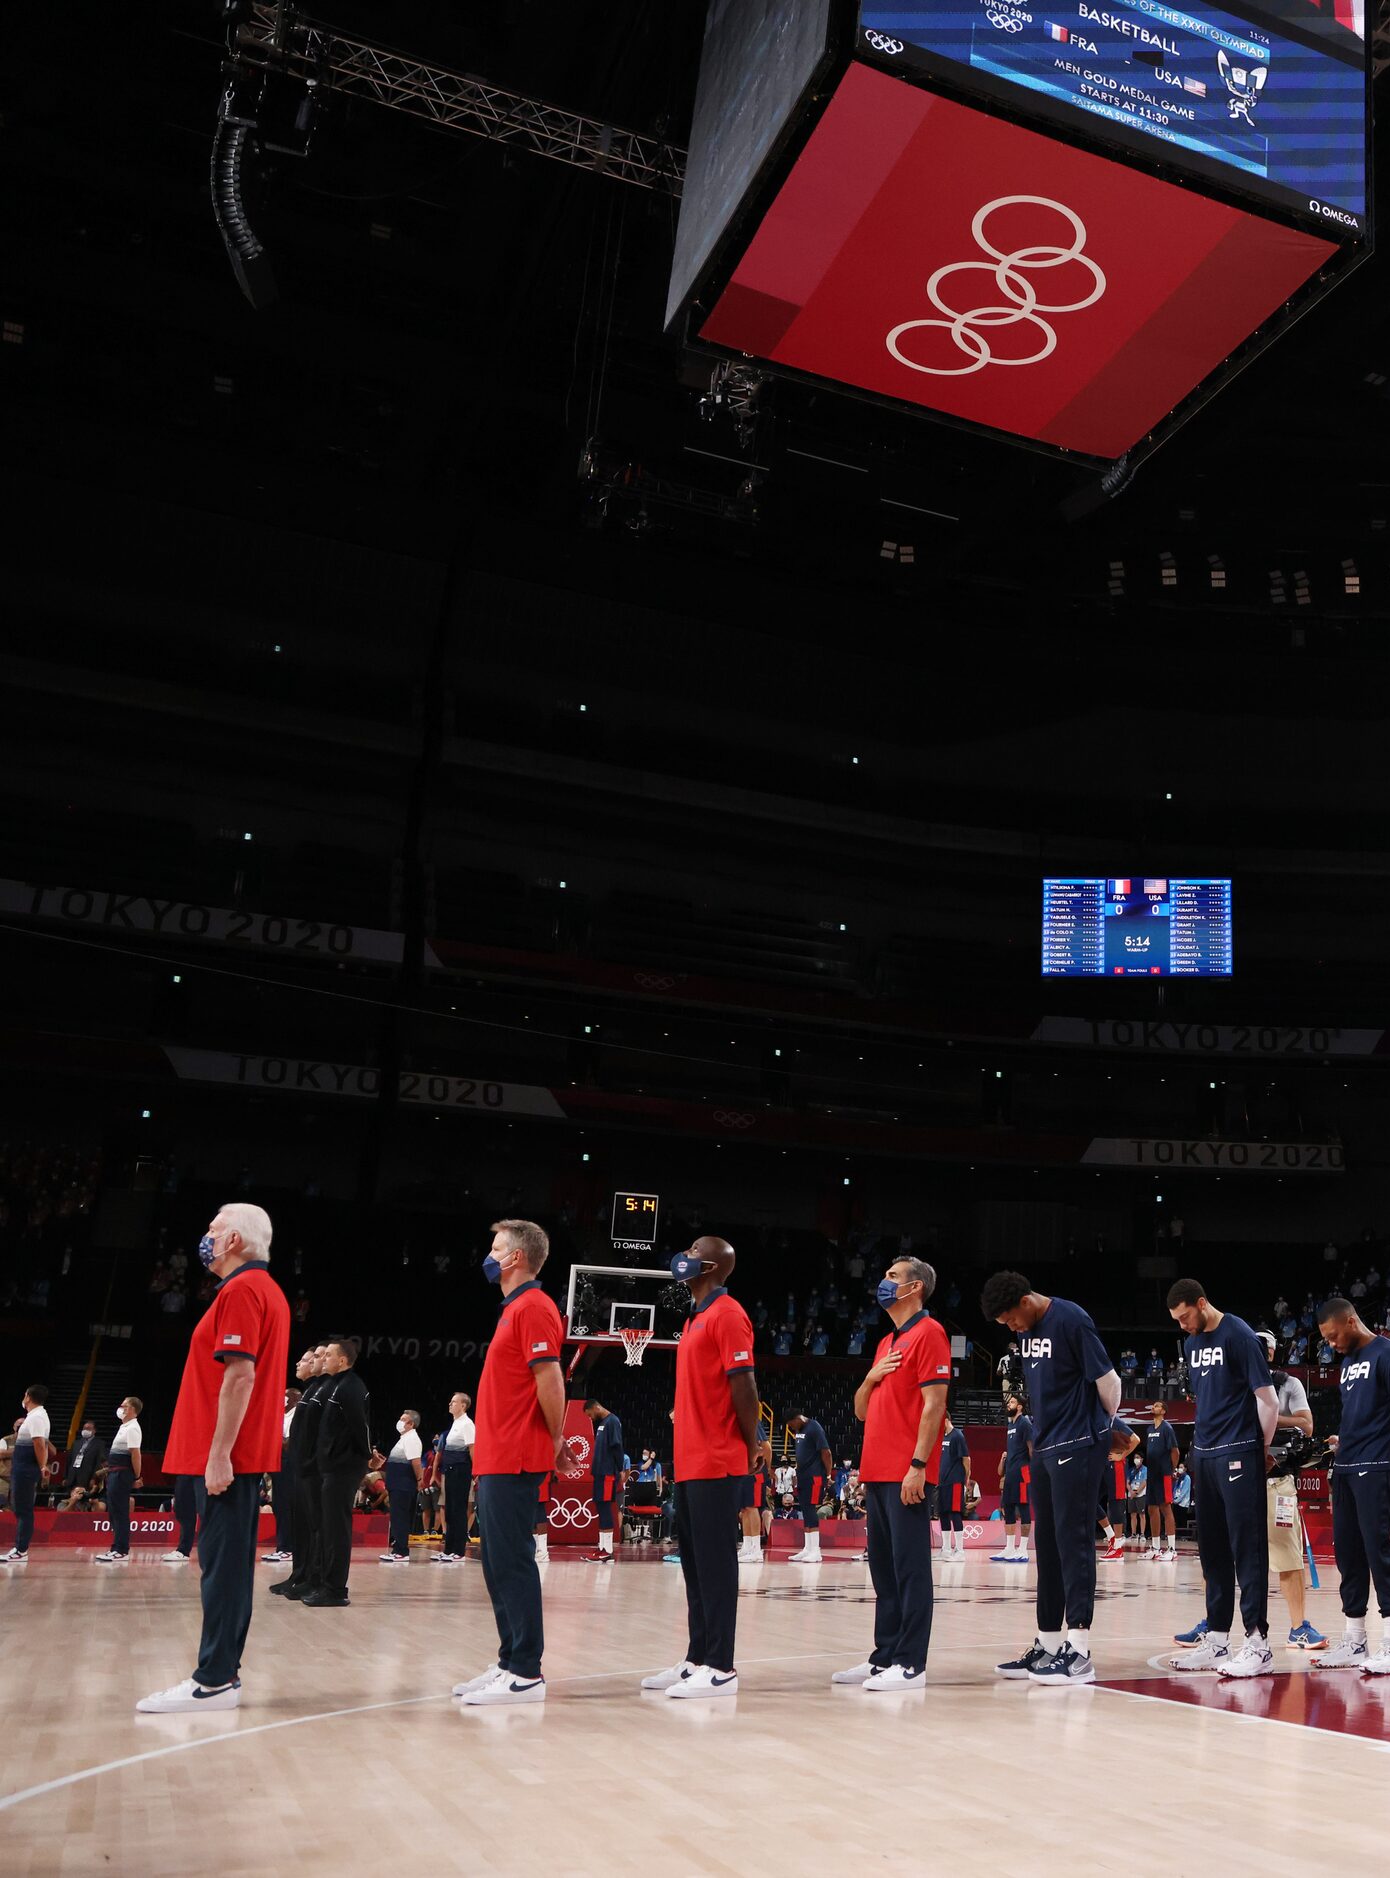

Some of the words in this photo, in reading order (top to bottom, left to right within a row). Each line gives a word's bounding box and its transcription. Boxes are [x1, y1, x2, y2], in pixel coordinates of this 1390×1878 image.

[1010, 8, 1032, 23] 2020
[1079, 3, 1181, 56] BASKETBALL
[1140, 0, 1155, 12] OF
[1158, 6, 1179, 23] THE
[1181, 16, 1208, 35] XXXII
[1210, 30, 1265, 58] OLYMPIAD
[1070, 34, 1099, 55] FRA
[1154, 67, 1183, 88] USA
[1054, 58, 1080, 75] MEN
[1083, 69, 1118, 89] GOLD
[1119, 83, 1159, 107] MEDAL
[1161, 100, 1195, 121] GAME
[1080, 83, 1120, 107] STARTS
[1122, 100, 1137, 113] AT
[1139, 106, 1169, 125] 11:30
[1071, 95, 1113, 118] SAITAMA
[1114, 111, 1143, 131] SUPER
[1144, 123, 1176, 141] ARENA
[1322, 206, 1358, 228] OMEGA
[25, 881, 210, 936] TOKYO
[224, 910, 355, 955] 2020
[1115, 905, 1123, 915] 0
[1151, 905, 1160, 915] 0
[1124, 936, 1151, 946] 5:14
[1085, 1019, 1218, 1049] TOKYO
[1232, 1026, 1329, 1053] 2020
[231, 1054, 383, 1094] TOKYO
[400, 1069, 505, 1107] 2020
[1130, 1139, 1248, 1166] TOKYO
[1260, 1144, 1345, 1168] 2020
[626, 1198, 655, 1211] 5:14
[622, 1242, 651, 1251] OMEGA
[1021, 1338, 1052, 1358] USA
[1191, 1347, 1224, 1368] USA
[1340, 1360, 1370, 1383] USA
[1303, 1478, 1320, 1490] 2020
[93, 1520, 138, 1532] TOO
[140, 1520, 174, 1532] 2020
